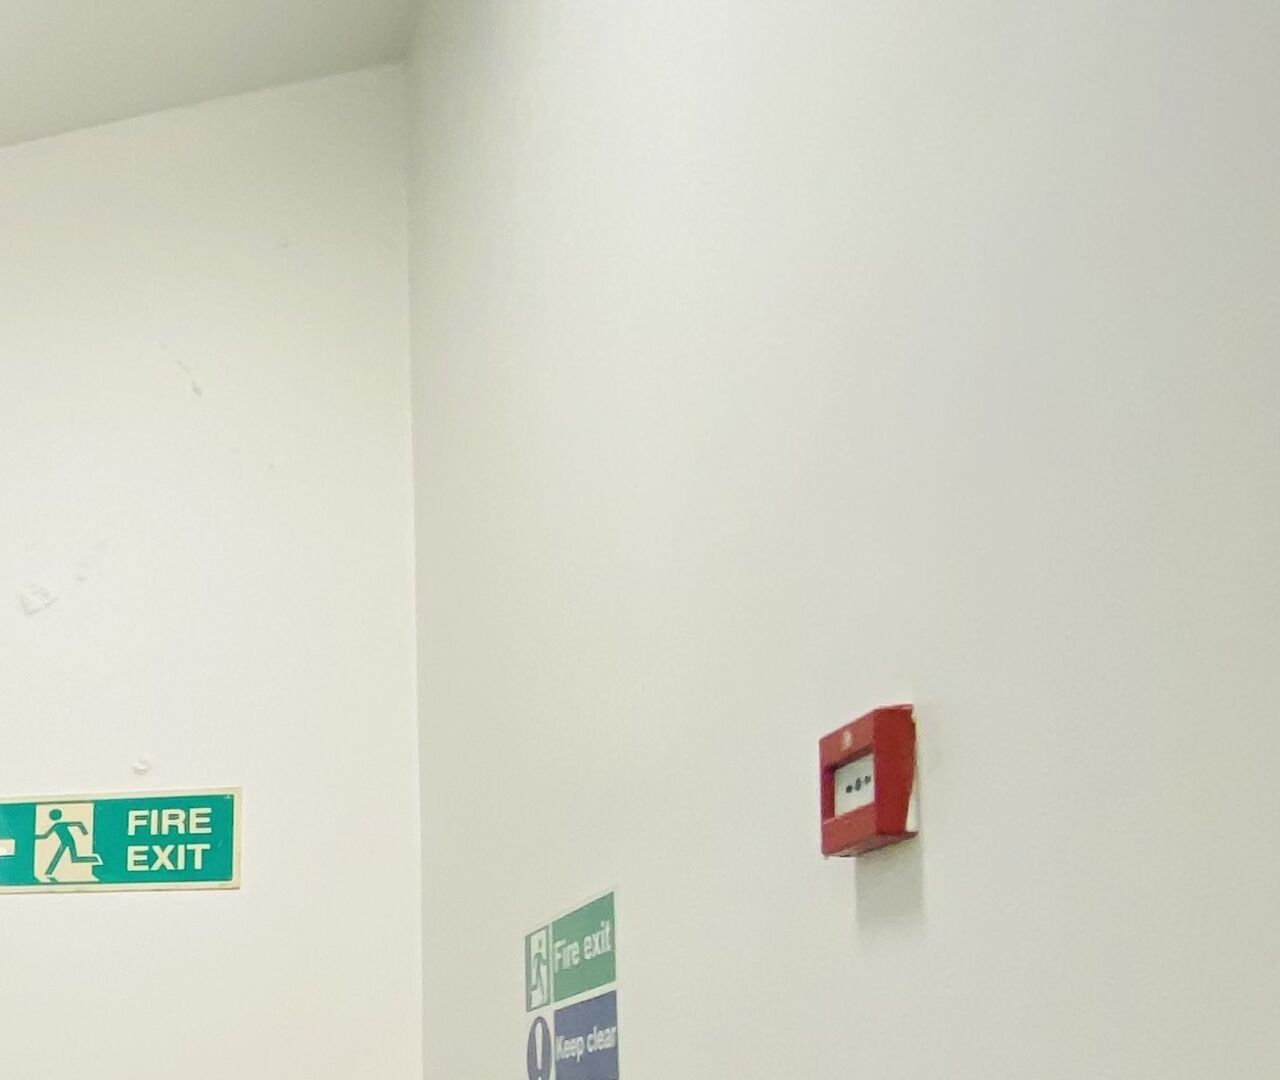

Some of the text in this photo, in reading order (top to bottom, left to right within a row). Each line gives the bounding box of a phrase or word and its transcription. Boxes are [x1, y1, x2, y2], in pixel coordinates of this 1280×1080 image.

[127, 808, 212, 836] FIRE
[127, 844, 211, 872] EXIT
[553, 920, 612, 974] Fire exit
[555, 1026, 617, 1063] Keep clear
